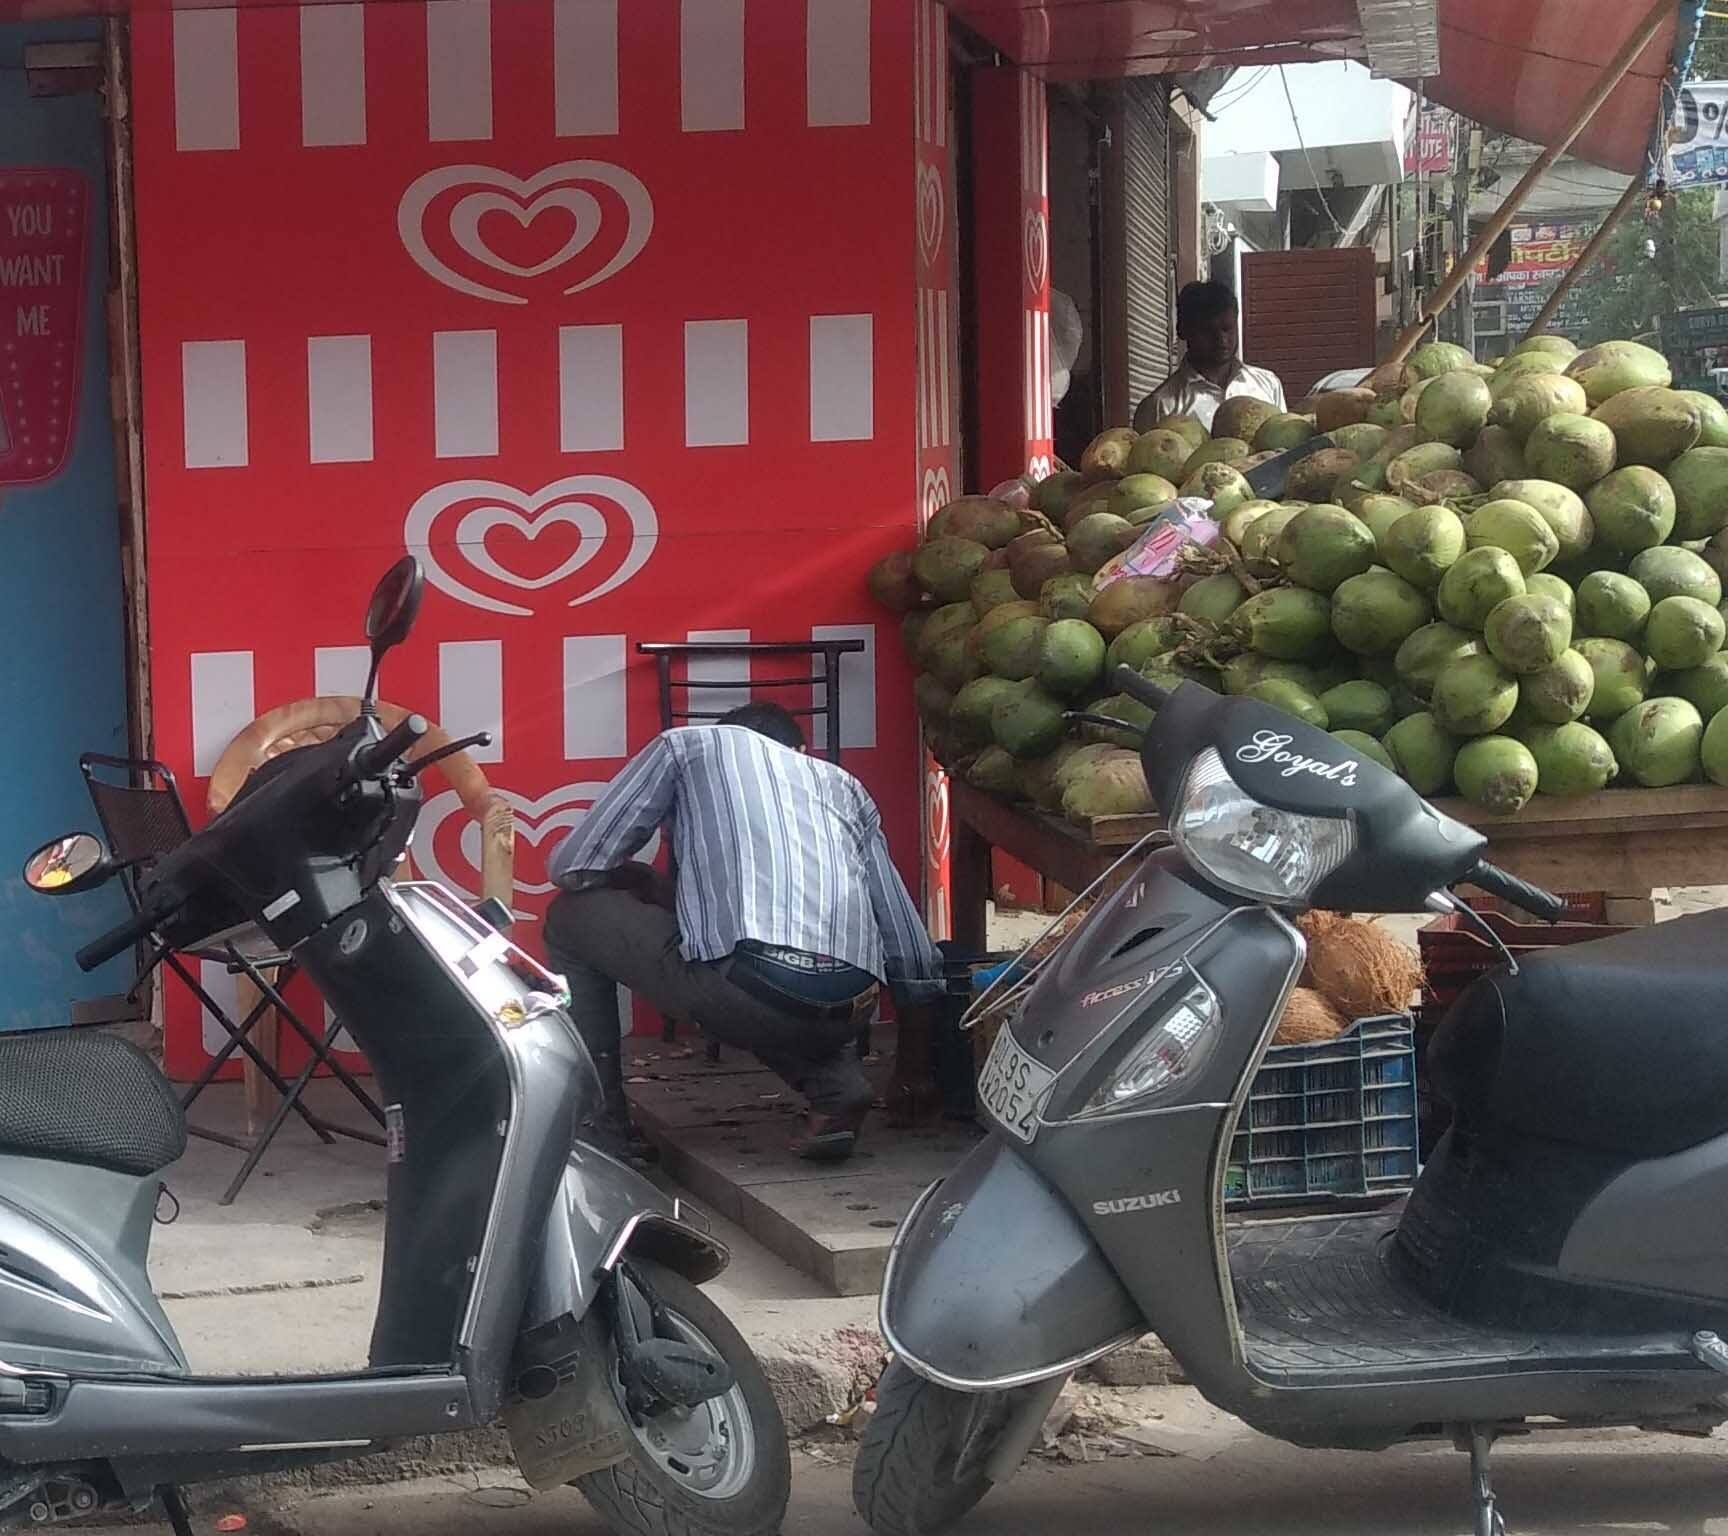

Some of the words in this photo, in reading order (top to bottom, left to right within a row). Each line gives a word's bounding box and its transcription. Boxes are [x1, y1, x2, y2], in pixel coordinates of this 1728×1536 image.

[7, 203, 52, 237] YOU
[16, 305, 51, 337] ME
[1236, 729, 1358, 786] Goyal's
[1093, 1189, 1181, 1215] SUZUKI
